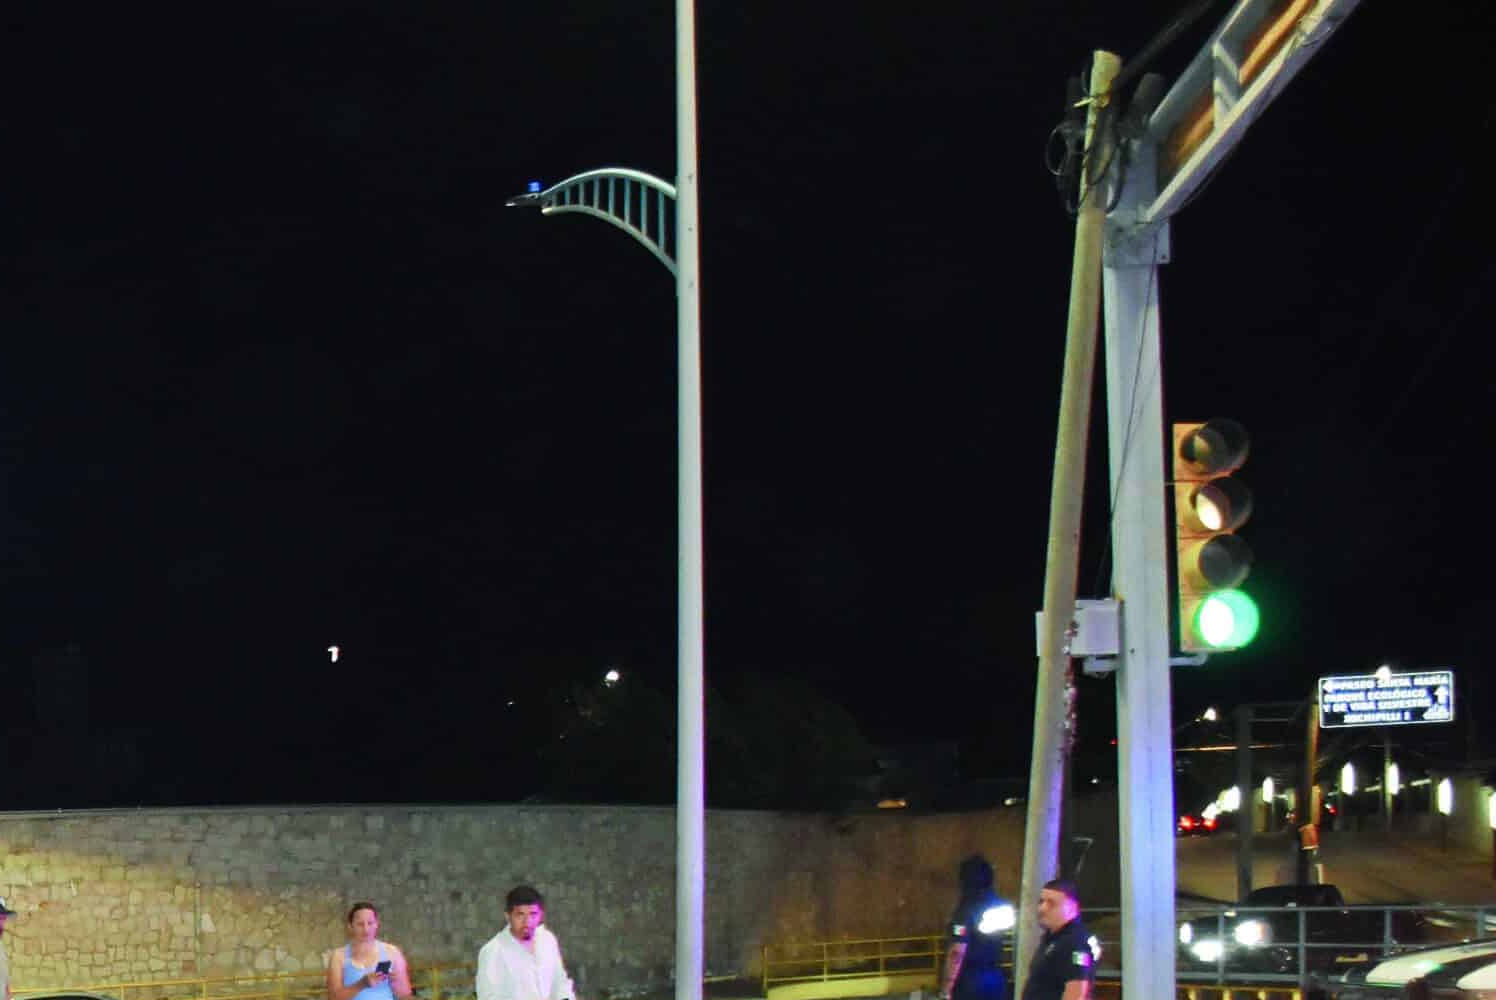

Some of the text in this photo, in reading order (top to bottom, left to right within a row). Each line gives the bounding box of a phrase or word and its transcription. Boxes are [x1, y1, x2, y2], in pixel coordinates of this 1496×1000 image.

[1367, 688, 1427, 700] ECOLÓGICO
[1323, 704, 1331, 712] Y
[1333, 703, 1347, 712] DE
